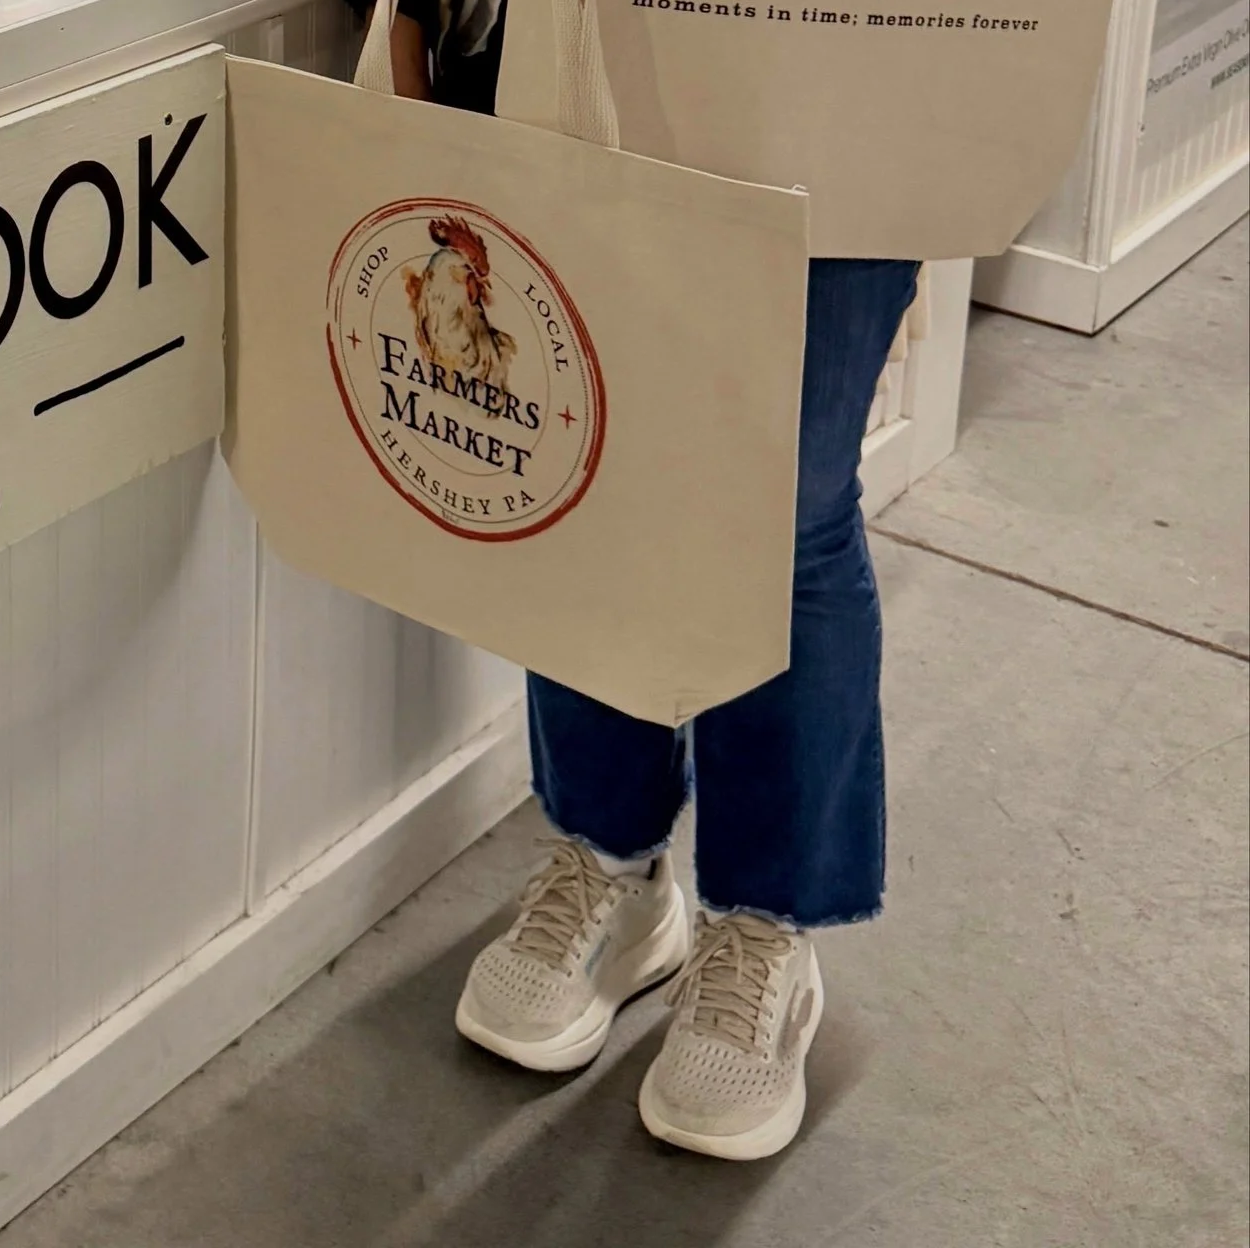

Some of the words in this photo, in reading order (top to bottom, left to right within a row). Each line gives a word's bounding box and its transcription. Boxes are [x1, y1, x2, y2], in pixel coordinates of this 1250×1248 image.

[766, 4, 792, 21] in
[801, 7, 858, 27] time;
[866, 11, 966, 29] memories
[972, 13, 1040, 31] forever
[357, 246, 390, 299] SHOP
[523, 282, 570, 373] LOCAL
[380, 429, 491, 515] HERSHEY
[502, 488, 536, 513] PA
